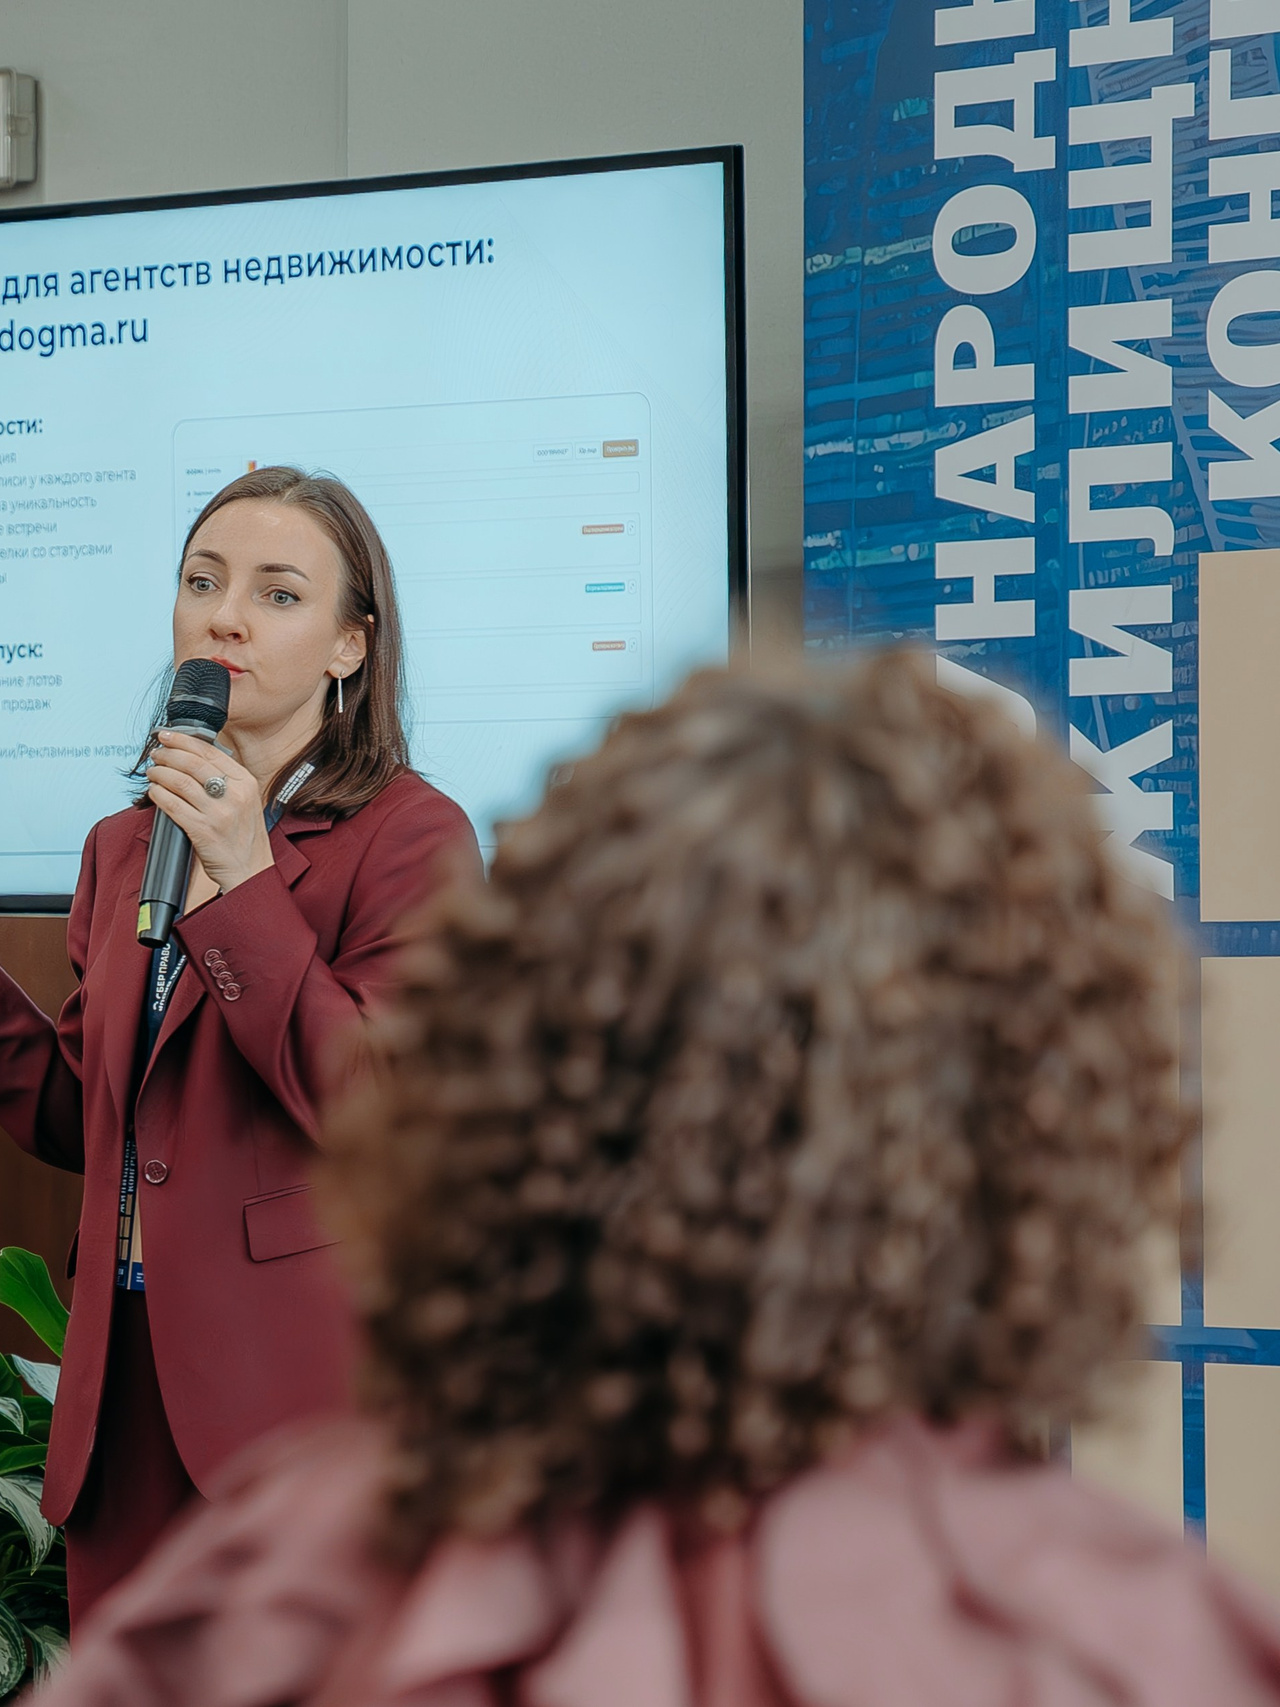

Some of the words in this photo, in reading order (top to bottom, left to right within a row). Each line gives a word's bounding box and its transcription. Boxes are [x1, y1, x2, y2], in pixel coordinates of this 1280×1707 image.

[2, 272, 59, 306] для
[70, 261, 212, 295] агентств
[224, 238, 494, 286] недвижимости:
[38, 471, 93, 487] каждого
[94, 469, 137, 484] агента
[8, 495, 98, 515] уникальность
[6, 522, 58, 538] встречи
[47, 543, 113, 561] статусами
[25, 674, 63, 688] лотов
[1, 698, 52, 714] продаж
[93, 744, 142, 762] матери
